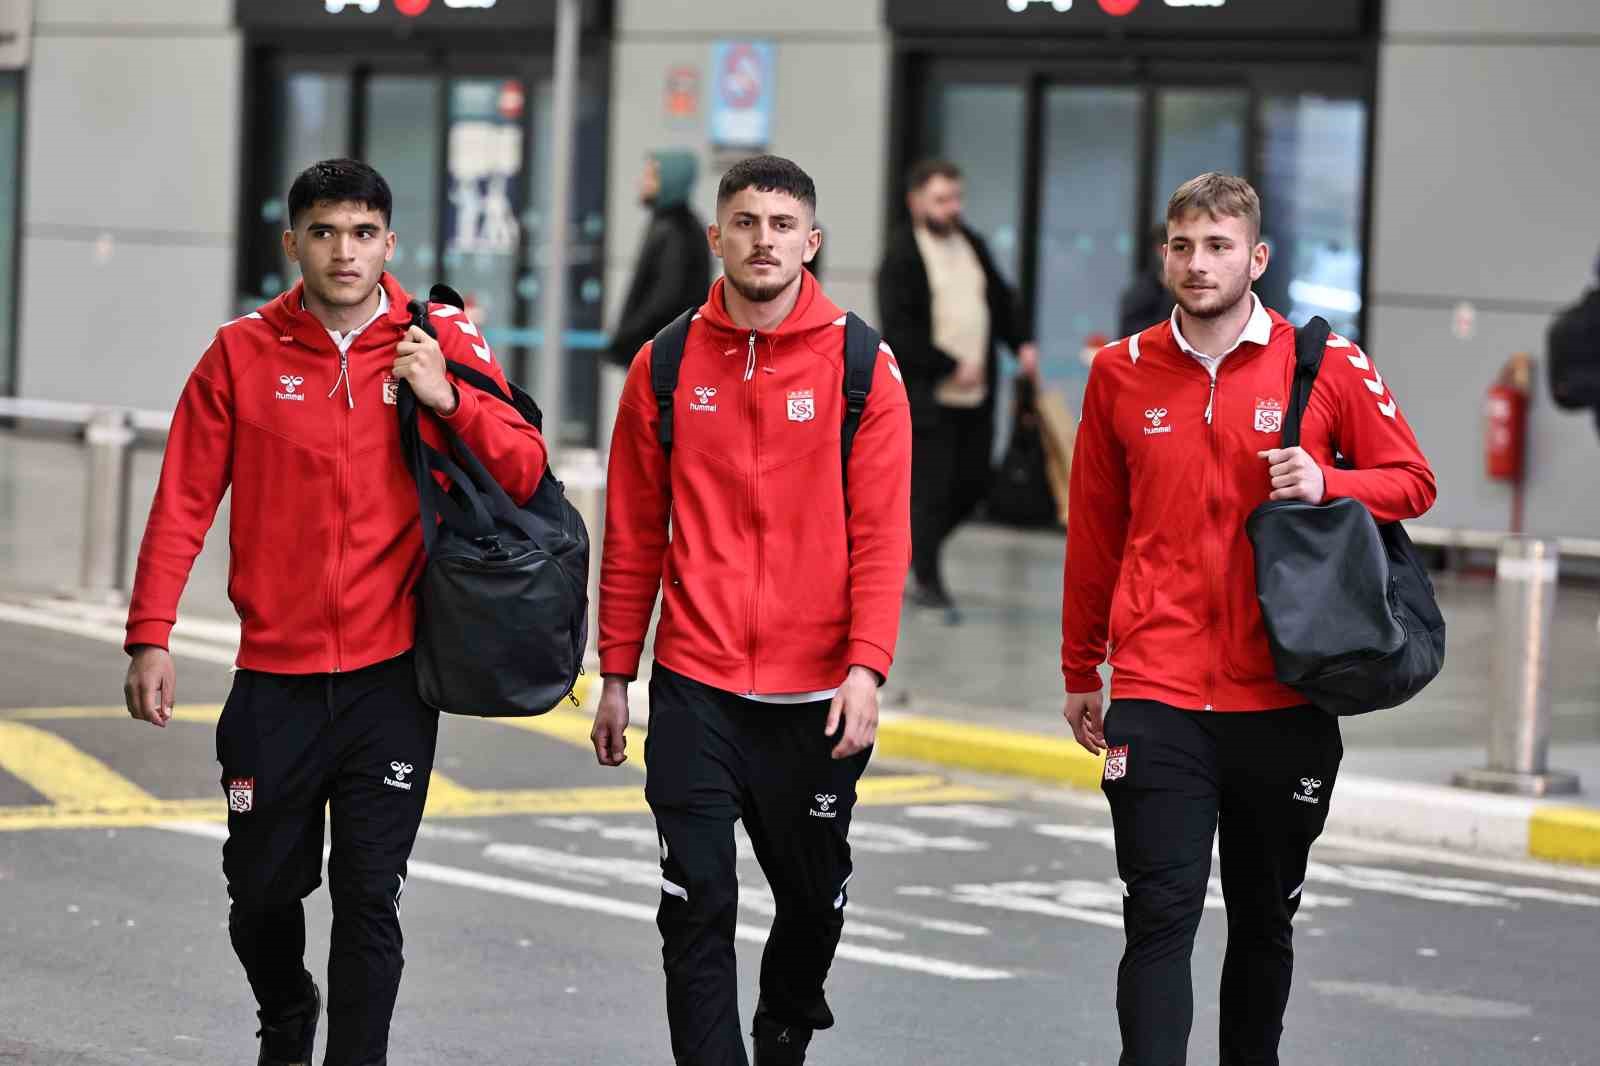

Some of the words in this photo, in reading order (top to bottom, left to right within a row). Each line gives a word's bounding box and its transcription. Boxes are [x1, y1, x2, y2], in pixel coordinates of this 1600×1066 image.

[275, 391, 305, 401] hummel
[690, 402, 717, 412] hummel
[1144, 424, 1171, 436] hummel
[384, 776, 412, 790] hummel
[1293, 792, 1319, 804] hummel
[809, 808, 837, 818] hummel
